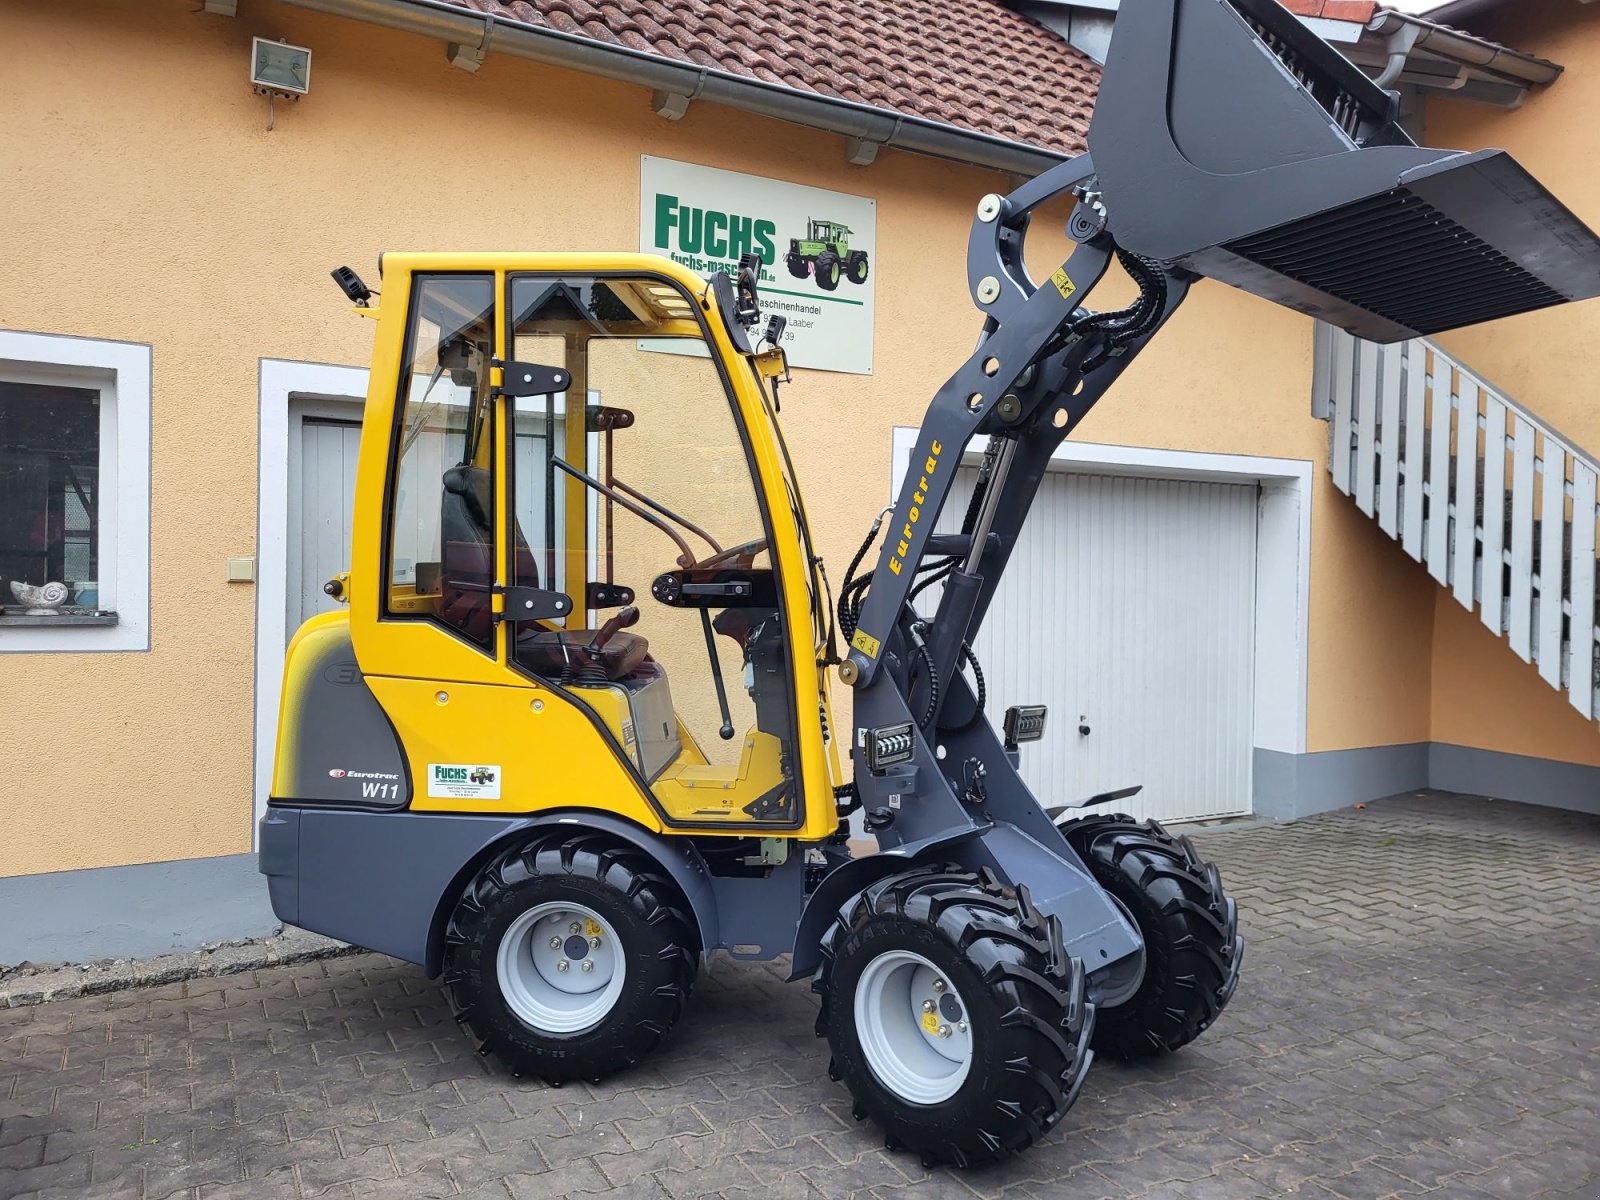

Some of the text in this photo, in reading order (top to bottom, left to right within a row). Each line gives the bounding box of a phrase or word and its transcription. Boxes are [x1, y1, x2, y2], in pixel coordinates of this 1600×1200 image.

[759, 299, 821, 315] aschinenhandel
[788, 317, 814, 329] Laaber
[888, 439, 942, 576] Eurotrac
[347, 770, 400, 780] Eurotrac
[362, 782, 399, 799] W11
